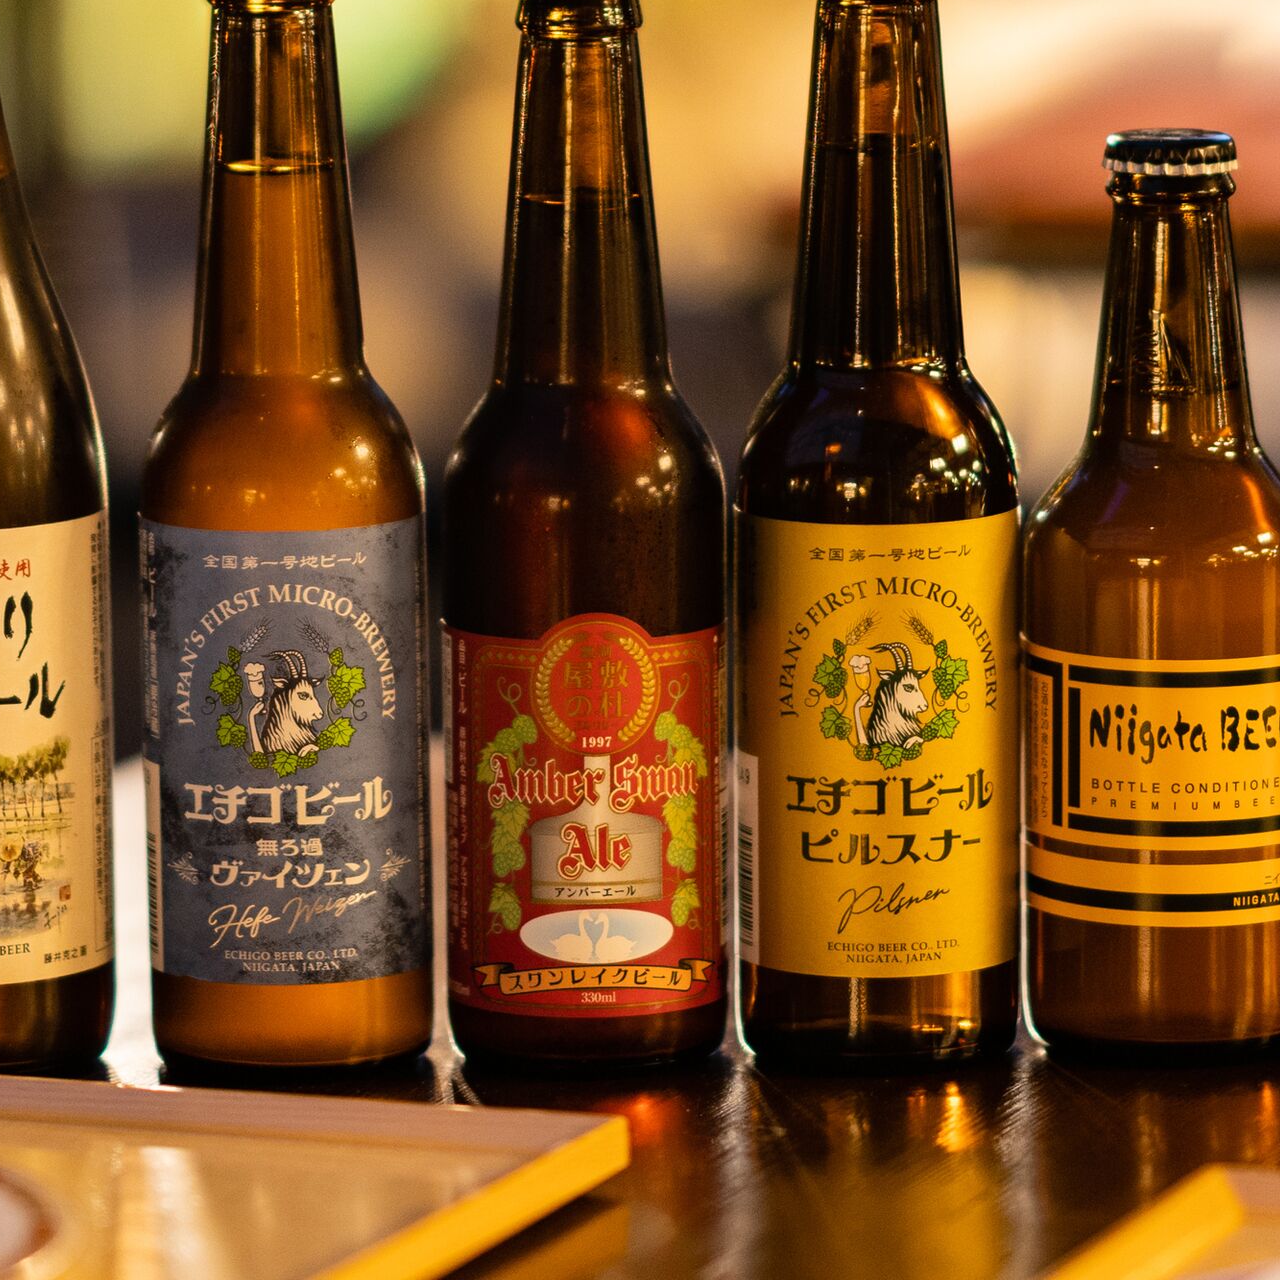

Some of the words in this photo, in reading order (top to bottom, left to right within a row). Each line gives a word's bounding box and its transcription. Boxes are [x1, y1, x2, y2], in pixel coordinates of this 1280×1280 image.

[202, 552, 367, 570] 全国第一号地ビール
[809, 544, 971, 562] 全国第一号地ビール
[178, 630, 206, 725] JAPAN'S
[201, 587, 262, 634] FIRST
[268, 583, 396, 720] MICRO-BREWERY
[780, 622, 810, 718] JAPAN'S
[806, 580, 868, 626] FIRST
[876, 576, 998, 711] MICRO-BREWERY
[582, 736, 612, 748] 1997
[1089, 703, 1208, 765] Niigata
[488, 753, 605, 808] Amber
[610, 753, 699, 813] Swan
[786, 768, 994, 816] エチゴビール
[1091, 777, 1161, 793] BOTTLE
[184, 775, 394, 826] エチゴビール
[256, 838, 323, 857] 無ろ過
[557, 821, 632, 880] Ale
[801, 828, 980, 865] ピルスナー
[210, 859, 370, 889] ヴァイツェン
[554, 885, 637, 898] アンバーエール
[1233, 892, 1280, 907] NIIGATA
[837, 882, 950, 934] Pilsner
[208, 904, 280, 948] Hefe
[282, 890, 377, 934] Weizen
[0, 943, 31, 956] BEER
[827, 941, 874, 952] ECHIGO
[878, 941, 907, 952] BEER
[936, 938, 960, 950] LTD.
[224, 950, 271, 961] ECHIGO
[273, 951, 304, 961] BEER
[906, 952, 942, 964] JAPAN
[301, 961, 340, 972] JAPAN
[509, 967, 683, 991] スワンレイクビール
[580, 991, 616, 1003] 330ml
